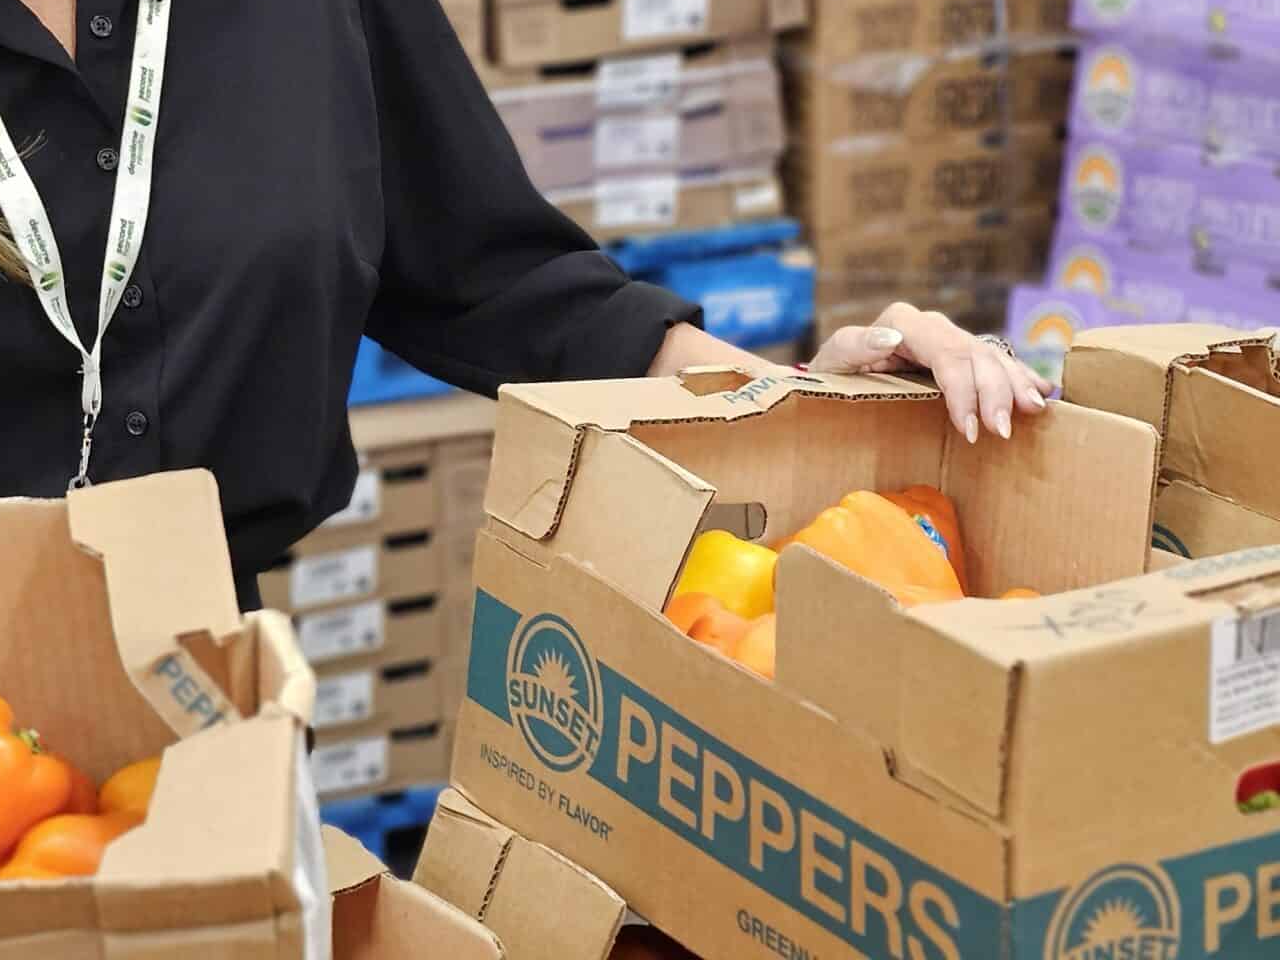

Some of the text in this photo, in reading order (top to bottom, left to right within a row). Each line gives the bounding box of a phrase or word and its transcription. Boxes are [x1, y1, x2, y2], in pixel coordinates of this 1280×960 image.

[509, 678, 602, 756] SUNSET
[480, 743, 535, 791] INSPIRED
[538, 782, 556, 803] BY
[616, 694, 961, 960] PEPPERS
[737, 909, 818, 960] GREEN
